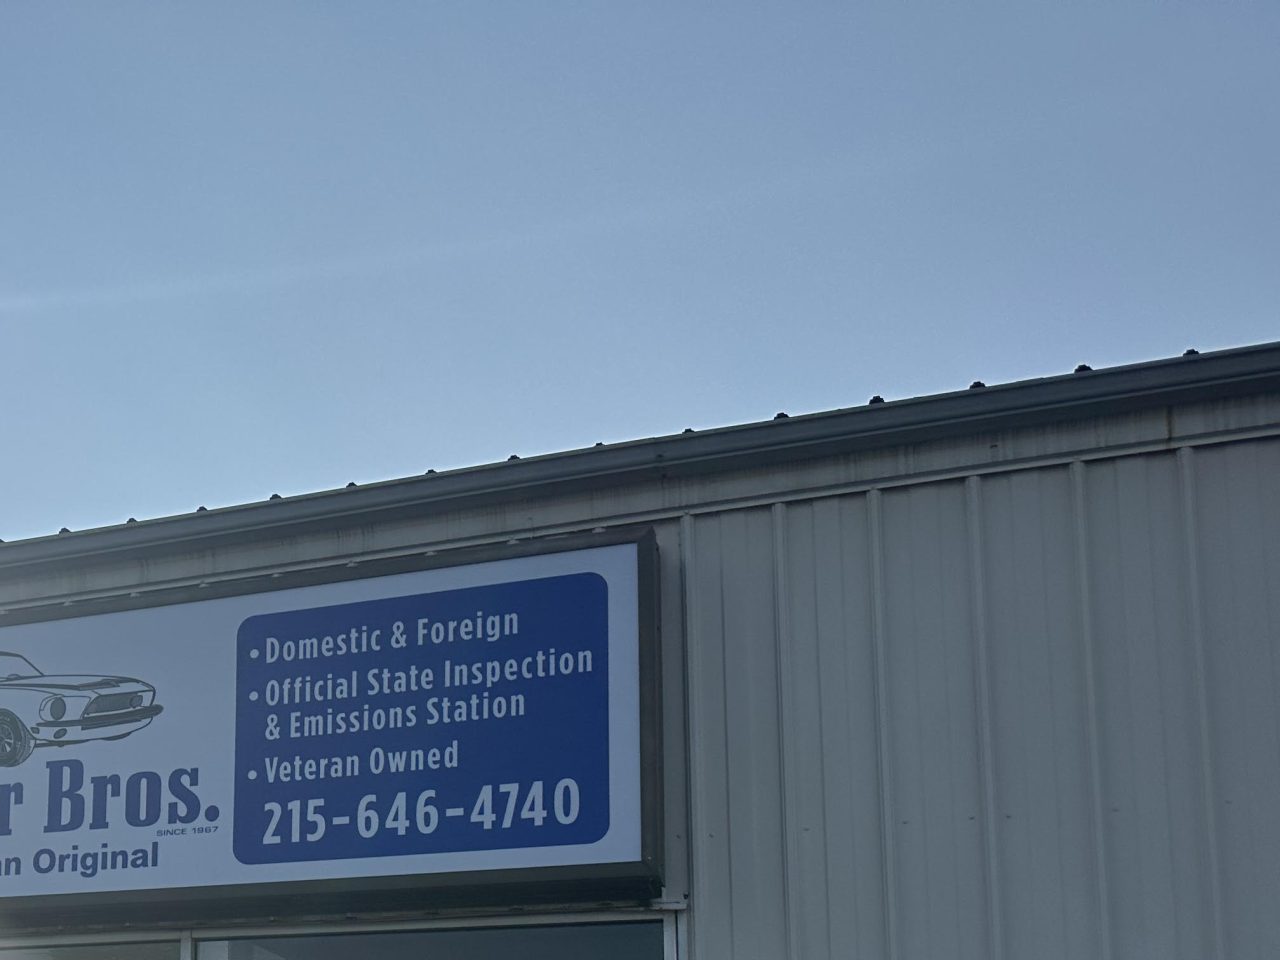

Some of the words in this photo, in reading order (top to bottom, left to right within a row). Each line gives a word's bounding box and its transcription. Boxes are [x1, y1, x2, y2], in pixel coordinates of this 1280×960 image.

[265, 629, 382, 664] Domestic
[390, 620, 408, 649] &
[417, 611, 520, 647] Foreign
[264, 670, 358, 706] Official
[367, 665, 434, 697] State
[444, 647, 594, 690] Inspection
[264, 713, 281, 741] &
[289, 704, 418, 739] Emissions
[426, 691, 526, 726] Station
[264, 754, 360, 784] Veteran
[369, 740, 459, 775] Owned
[43, 758, 220, 834] Bros.
[262, 777, 582, 845] 215-646-4740
[156, 827, 188, 837] SINCE
[192, 825, 219, 835] 1967
[33, 841, 158, 878] Original
